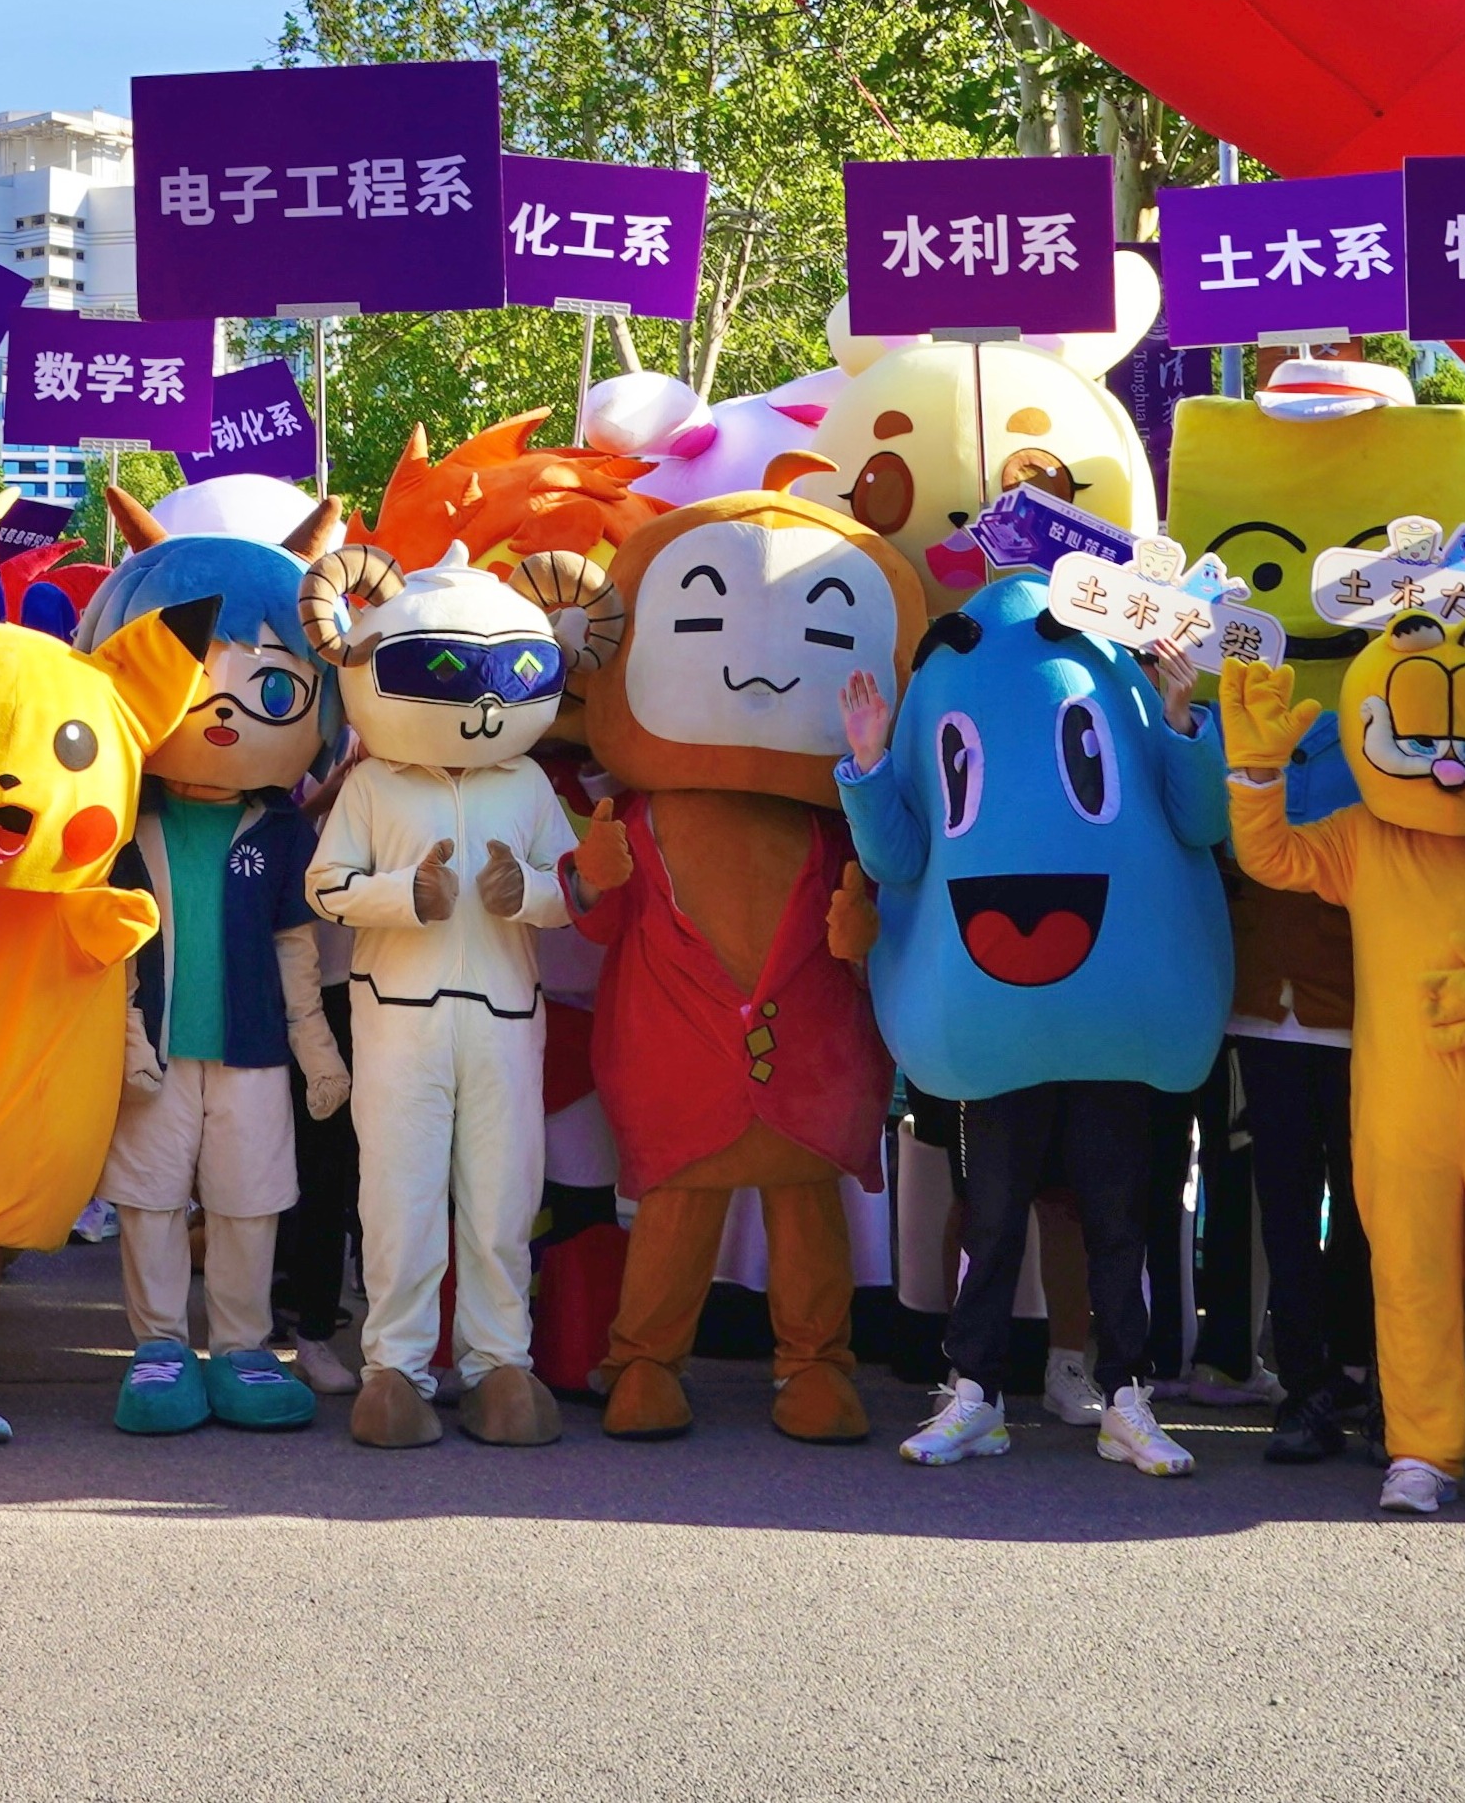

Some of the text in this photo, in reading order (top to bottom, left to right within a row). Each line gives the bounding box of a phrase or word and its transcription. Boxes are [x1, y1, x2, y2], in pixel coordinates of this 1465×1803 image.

[160, 154, 473, 226] 电子工程系
[508, 202, 672, 267] 化工系
[882, 212, 1080, 278] 水利系
[1199, 222, 1394, 291] 土木系
[33, 351, 186, 405] 数学系
[1131, 350, 1149, 421] Tsinghua
[192, 400, 303, 461] 动化系
[1070, 575, 1263, 664] 土木大类
